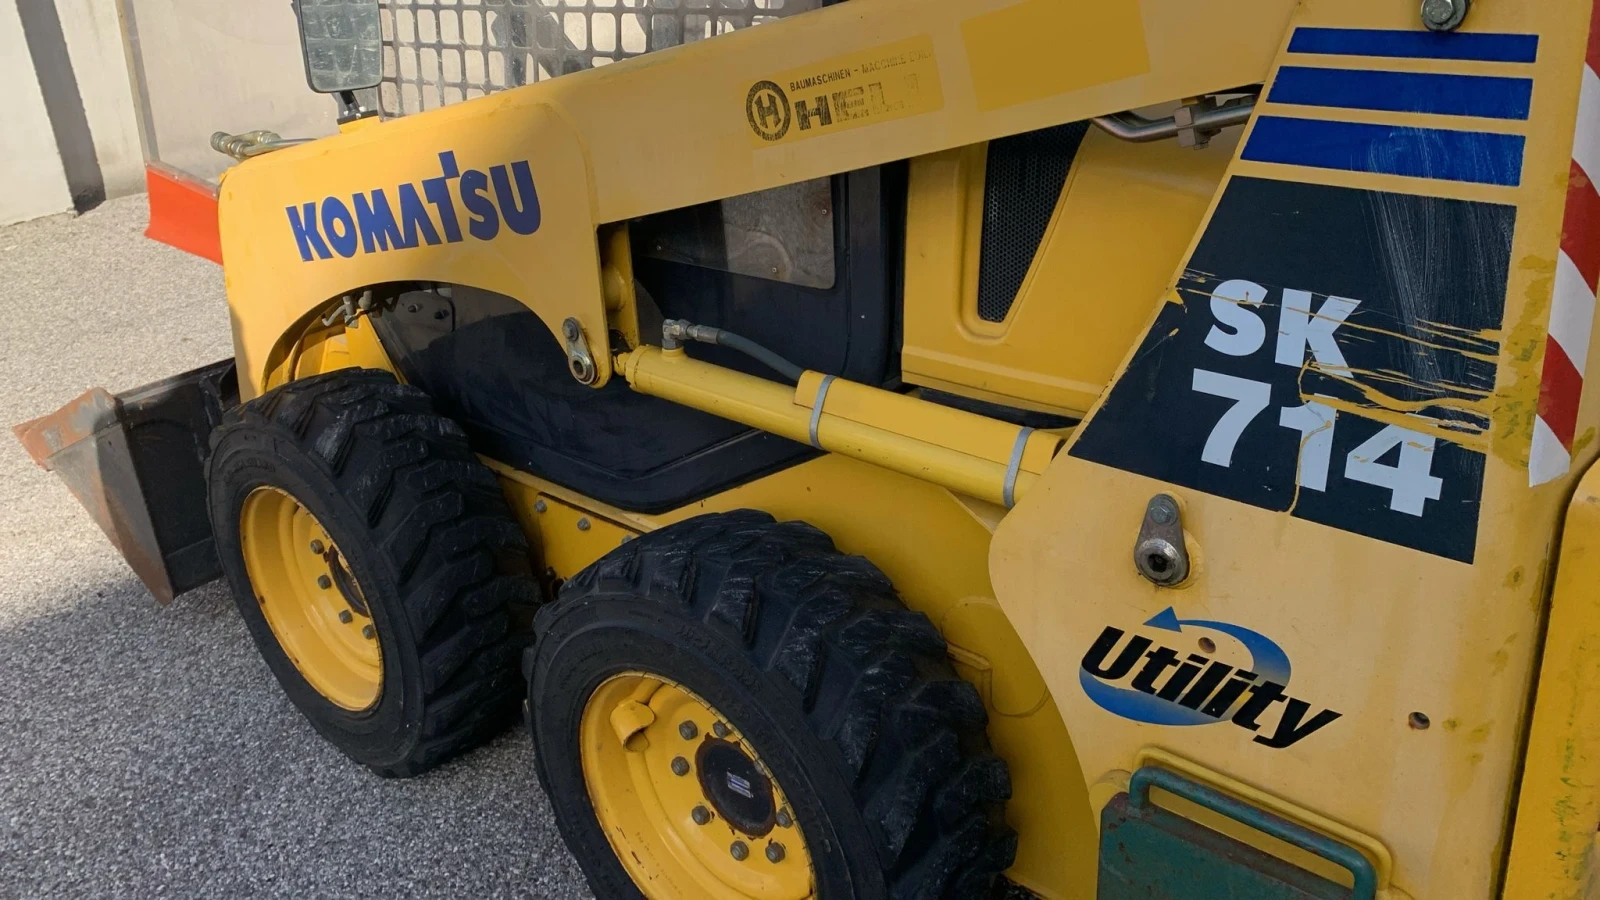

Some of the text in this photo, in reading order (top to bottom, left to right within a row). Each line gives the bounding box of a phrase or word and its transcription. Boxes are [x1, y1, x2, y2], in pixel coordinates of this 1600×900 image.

[790, 68, 851, 92] BAUMASCHINEN
[861, 54, 907, 75] MACCHINE
[285, 150, 541, 263] KOMATSU
[1203, 279, 1362, 378] SK
[1191, 368, 1444, 517] 714
[1081, 625, 1343, 749] Utility
